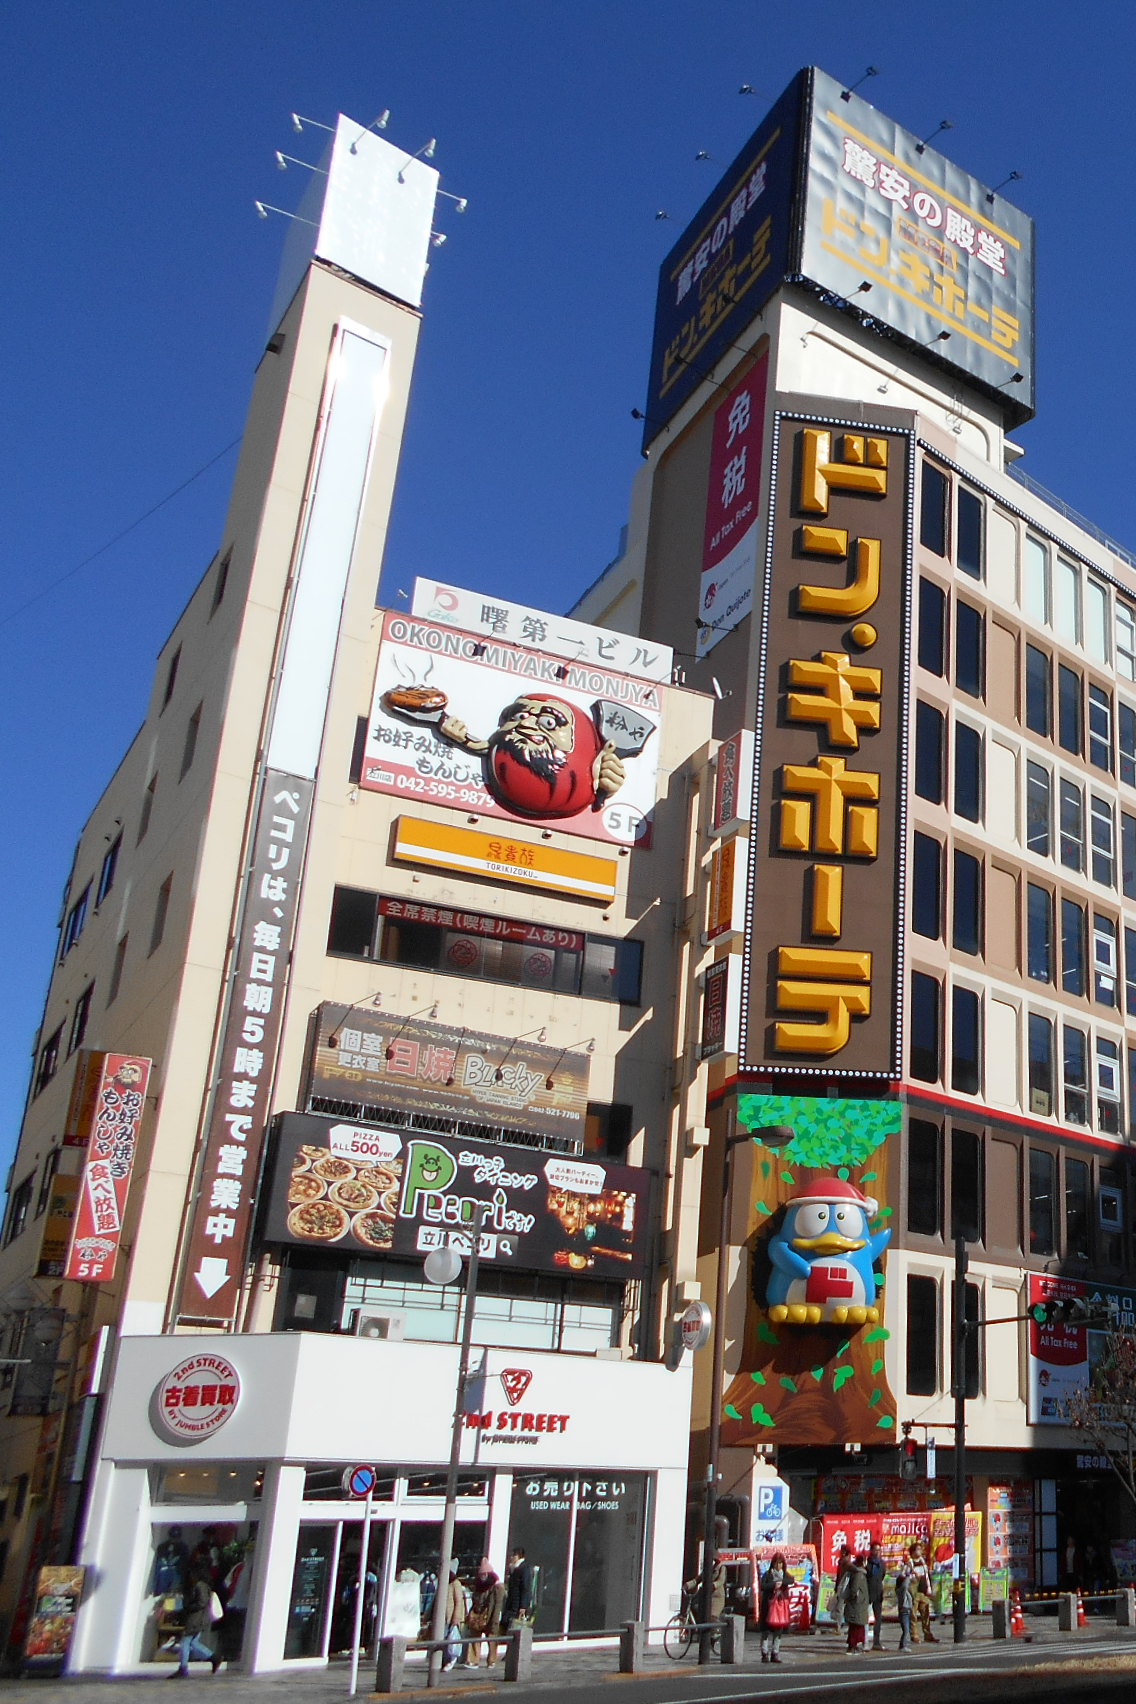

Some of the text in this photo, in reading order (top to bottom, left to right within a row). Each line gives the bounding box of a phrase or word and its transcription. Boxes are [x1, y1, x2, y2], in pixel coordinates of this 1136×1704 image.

[842, 136, 1009, 277] 驚安の殿堂
[676, 161, 768, 305] 驚安の殿堂
[721, 389, 751, 509] 免税
[721, 520, 734, 542] Tax
[735, 500, 752, 526] Free
[480, 603, 660, 669] 曙第一ビル
[567, 665, 661, 710] MONJYA
[605, 711, 645, 741] 粉や
[397, 774, 496, 808] 042-595-9879
[485, 862, 534, 879] TORIKIZOKU
[206, 788, 301, 1244] ペコリは、毎日朝5時まで営業中
[340, 1027, 384, 1058] 個室
[337, 1051, 381, 1073] 更衣室
[95, 1088, 121, 1155] もんじゃ
[110, 1089, 142, 1179] お好み焼き
[332, 1144, 350, 1154] ALL
[352, 1131, 381, 1143] PIZZA
[474, 1167, 538, 1190] ダイニング
[90, 1162, 118, 1233] 食べ放題
[78, 1263, 103, 1277] 5F
[1050, 1337, 1062, 1347] Tax
[174, 1357, 233, 1381] 2nd STREET
[165, 1384, 236, 1407] 古着買取
[175, 1419, 205, 1431] JUMBLE
[206, 1407, 228, 1429] STORE
[496, 1411, 570, 1433] STREET
[530, 1501, 548, 1510] USED
[550, 1501, 570, 1510] WEAR
[760, 1487, 774, 1513] P
[831, 1529, 871, 1552] 免税
